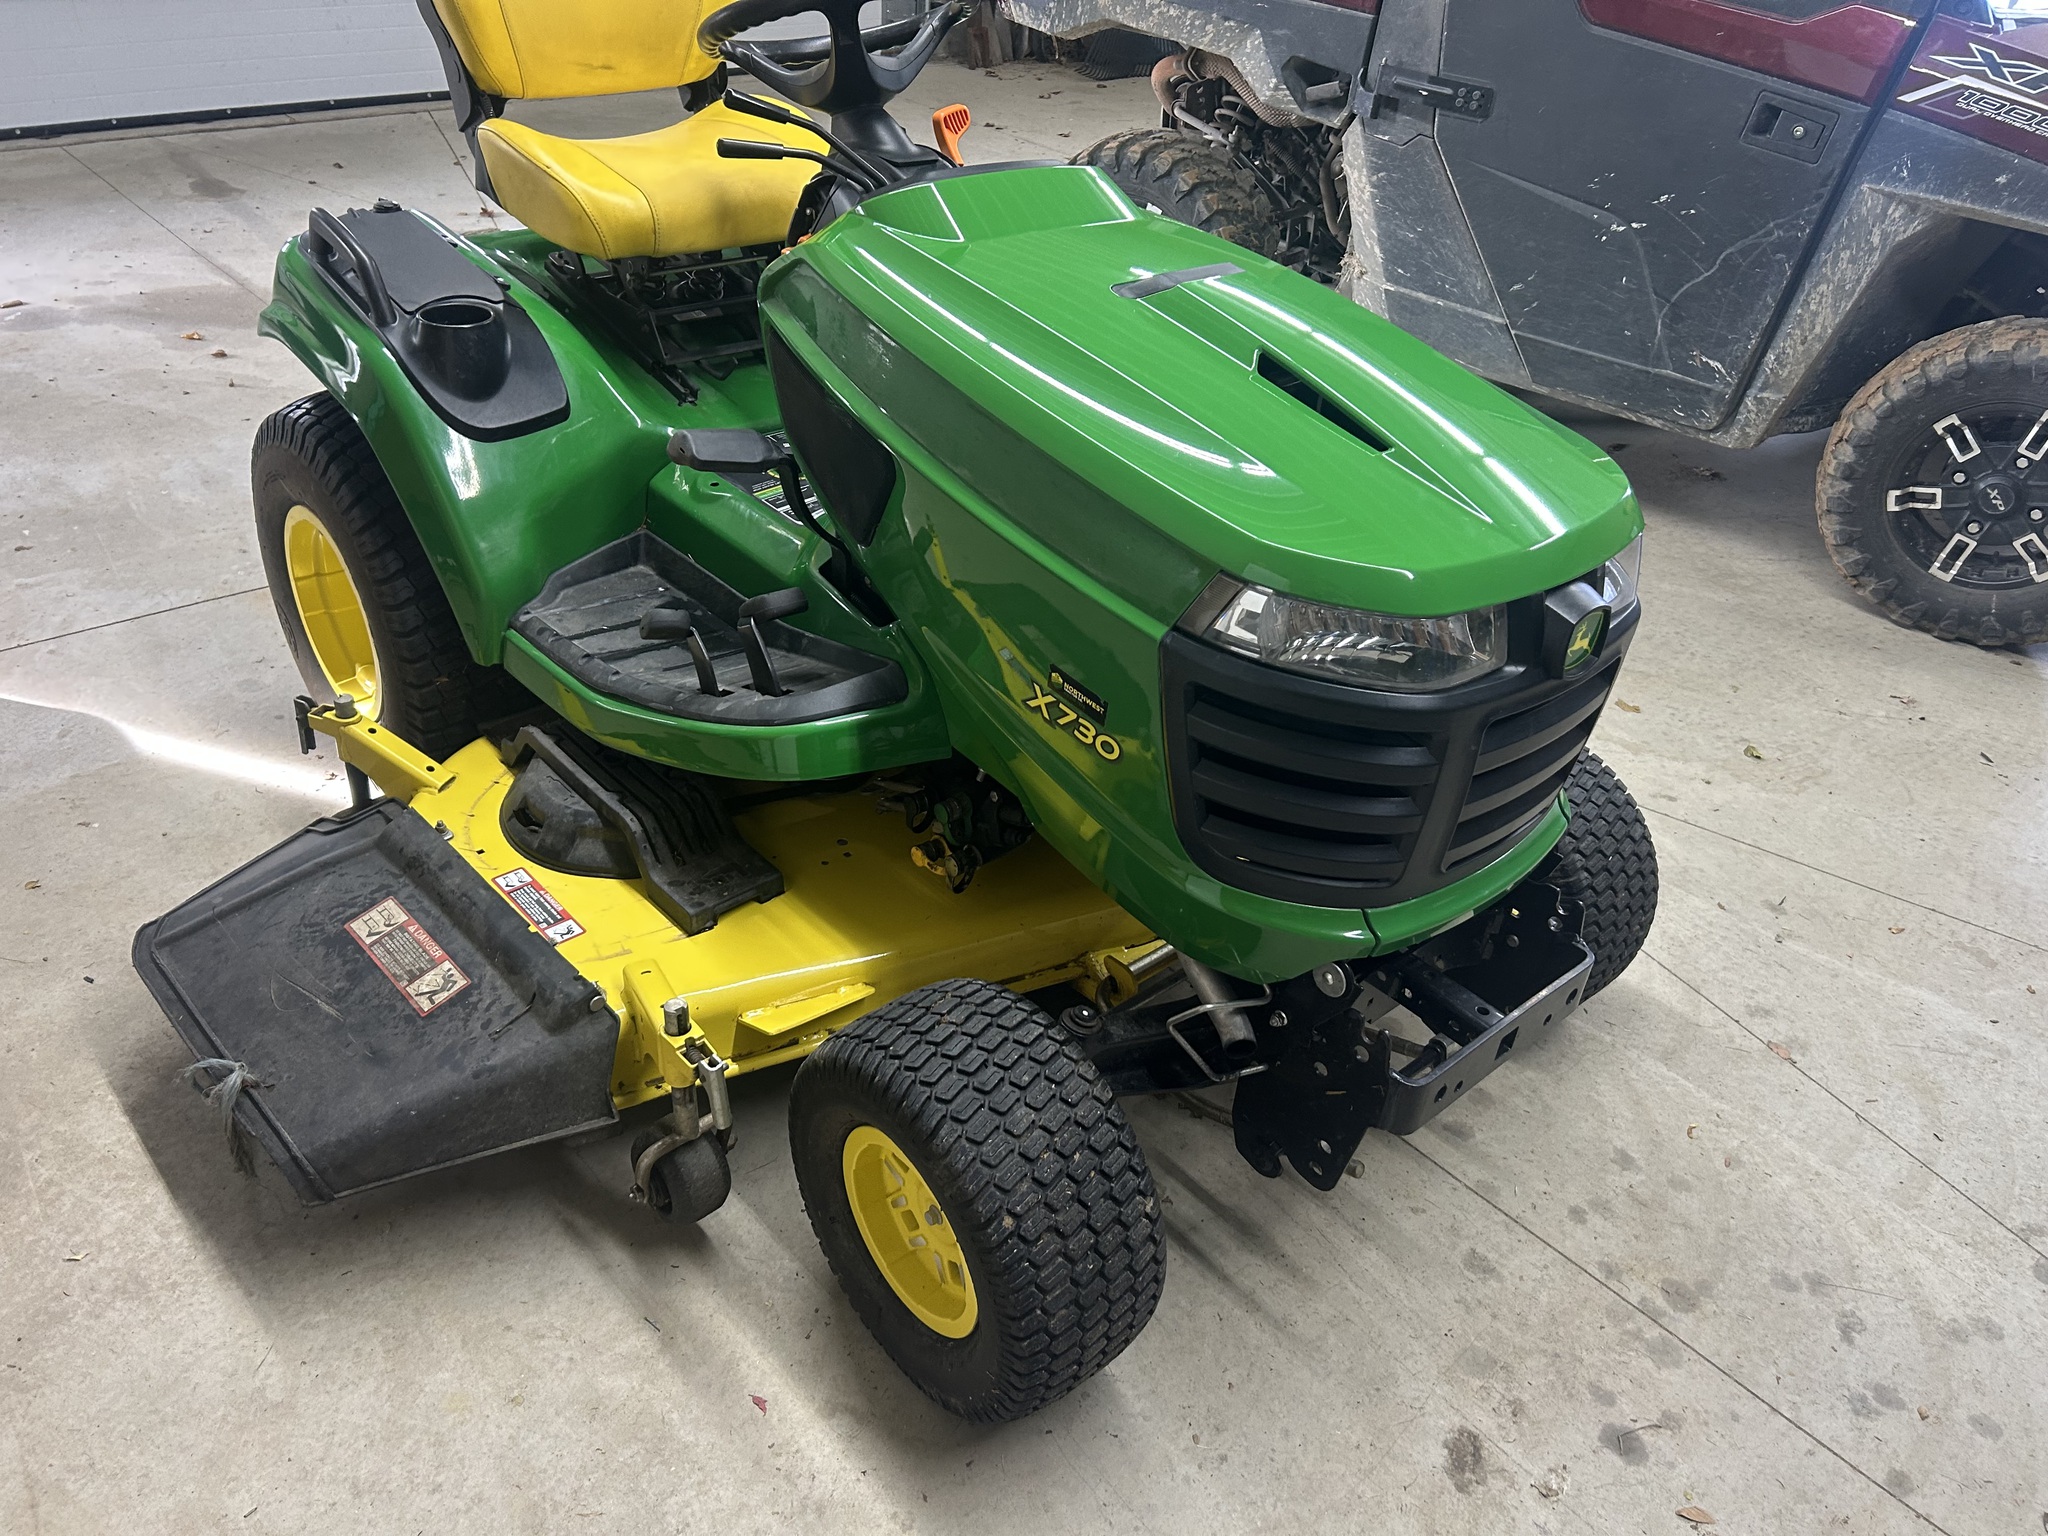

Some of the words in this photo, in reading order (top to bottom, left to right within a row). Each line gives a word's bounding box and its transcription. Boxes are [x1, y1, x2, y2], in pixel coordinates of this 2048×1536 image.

[1956, 102, 1982, 114] DUAL
[1983, 111, 2036, 132] OVERHEAD
[1986, 487, 2005, 510] XP
[1063, 682, 1105, 714] NORTHWEST
[1025, 682, 1120, 760] X730
[543, 892, 564, 911] DANGER
[414, 929, 443, 959] DANGER
